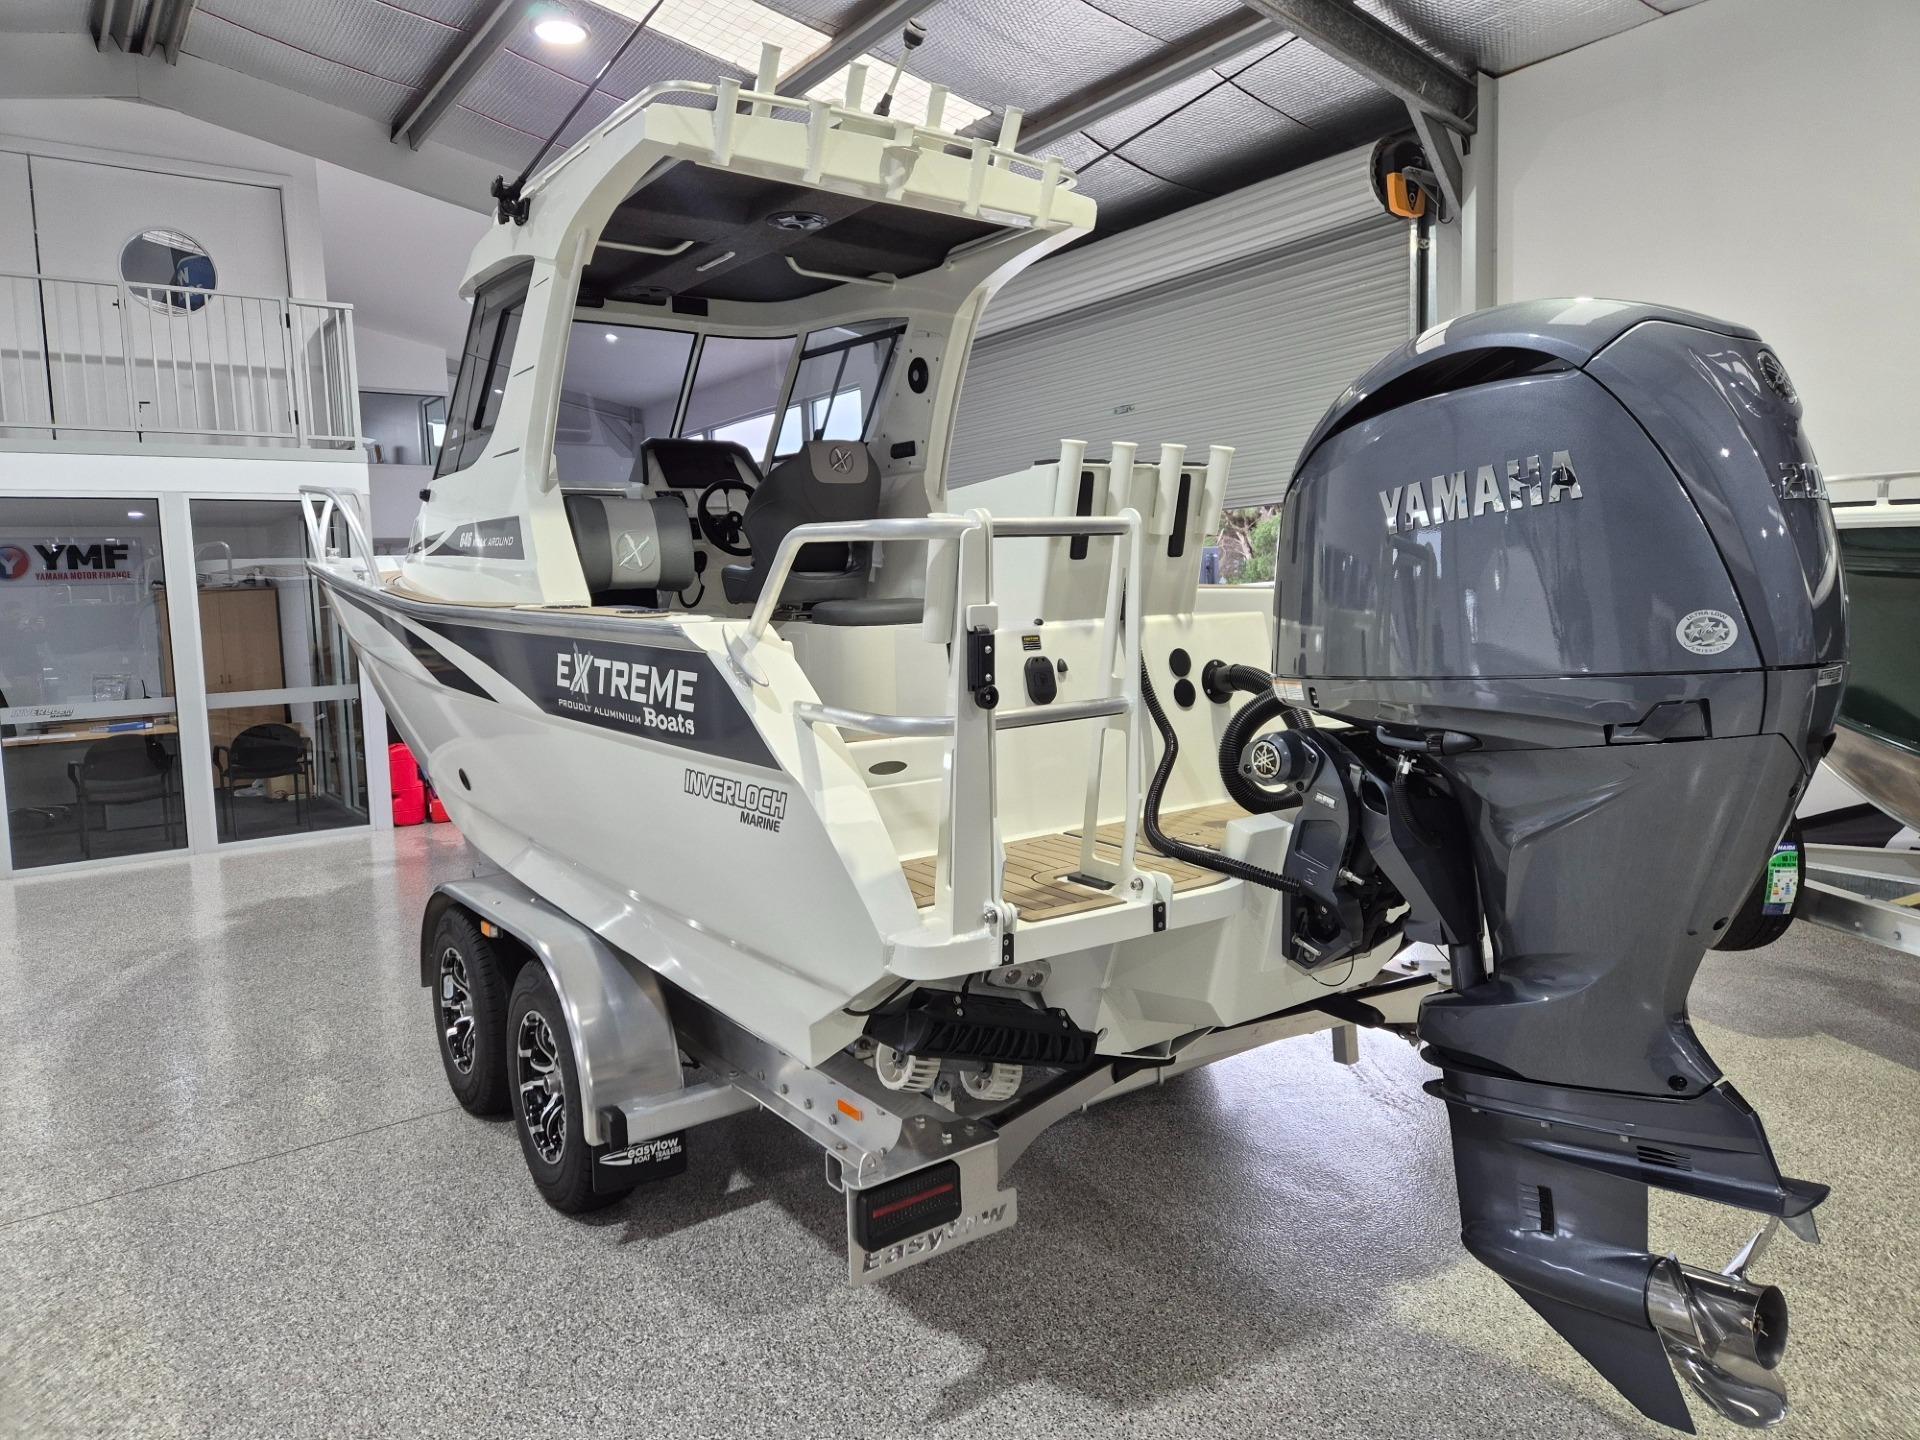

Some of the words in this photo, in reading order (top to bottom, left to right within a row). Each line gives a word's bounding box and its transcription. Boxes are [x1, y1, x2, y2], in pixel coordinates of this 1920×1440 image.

[1379, 450, 1583, 535] YAMAHA
[33, 544, 129, 571] YMF
[35, 571, 68, 581] YAMAHA
[70, 570, 98, 580] MOTOR
[99, 569, 132, 579] FINANCE
[556, 642, 699, 713] EXTREME
[558, 698, 592, 713] PROUDLY
[593, 706, 643, 726] ALUMINIUM
[643, 706, 696, 736] Boats
[684, 767, 788, 820] INVERLOCH
[739, 810, 781, 833] MARINE
